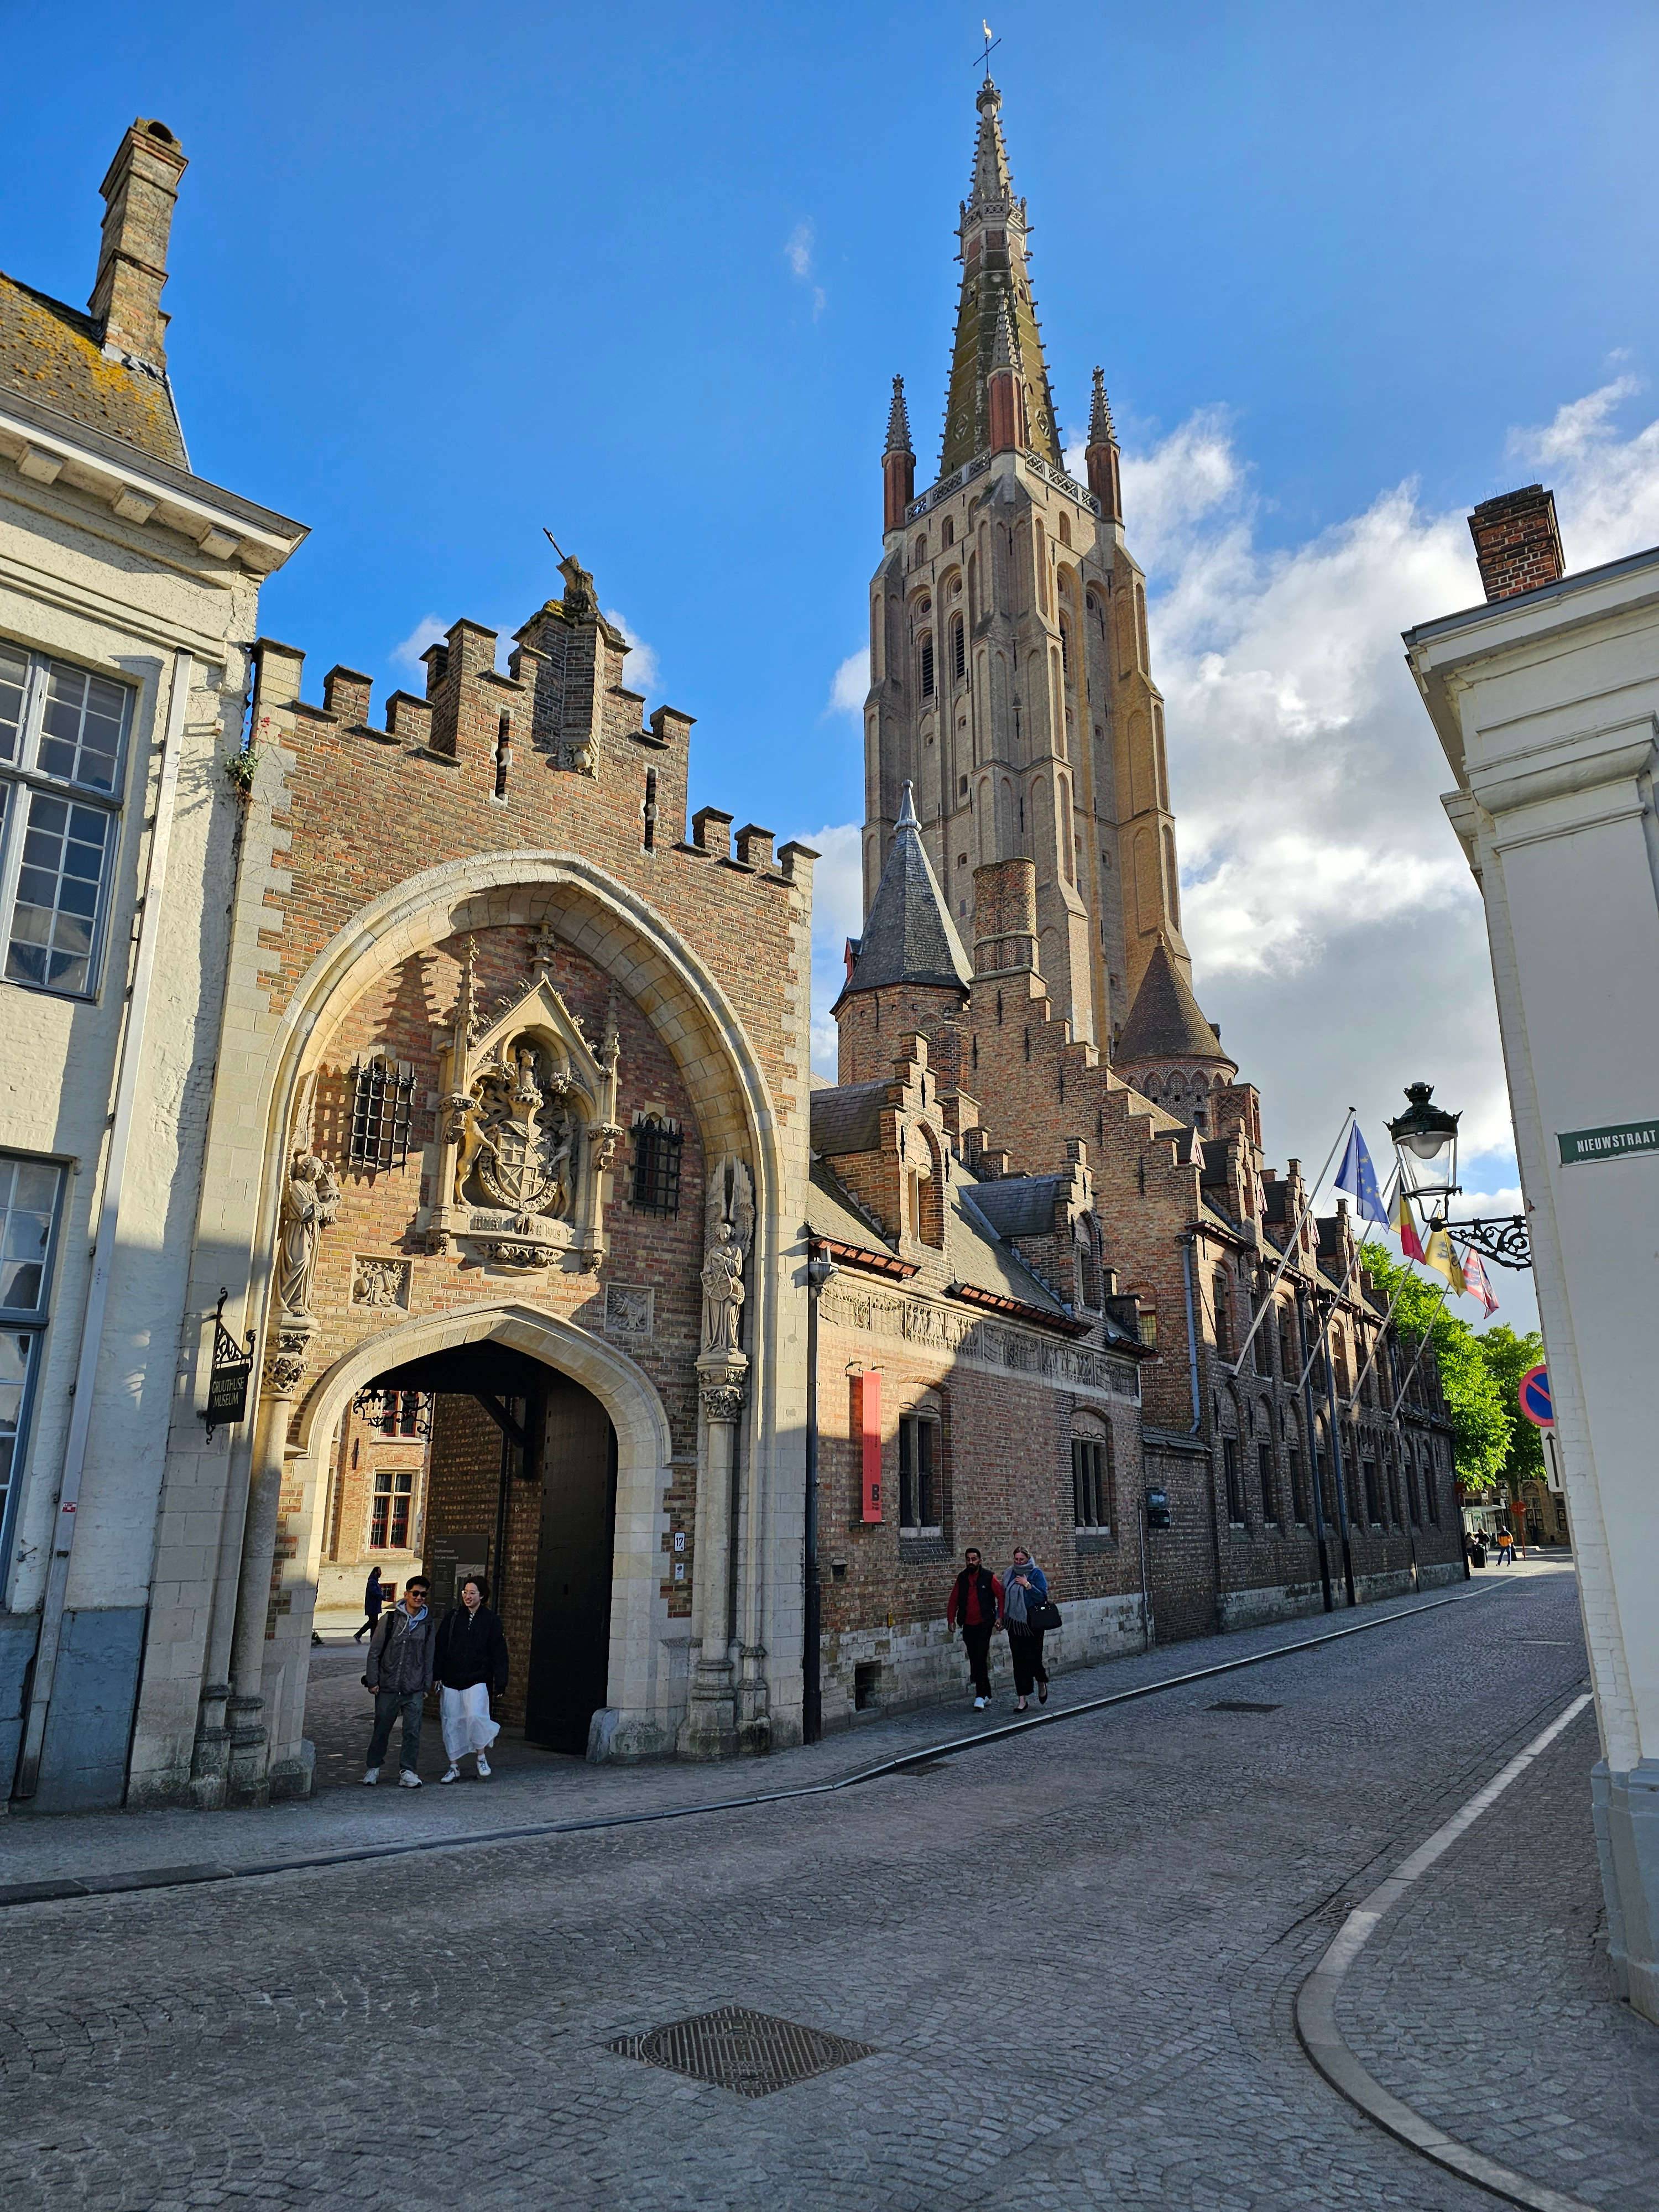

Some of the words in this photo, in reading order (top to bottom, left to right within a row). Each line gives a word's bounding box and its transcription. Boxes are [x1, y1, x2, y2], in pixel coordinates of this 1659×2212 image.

[1577, 1130, 1656, 1152] NIEUWSTRAAT
[212, 1376, 244, 1394] GRUUTHUSE
[212, 1392, 238, 1408] MUSEUM
[872, 1484, 880, 1501] B
[676, 1537, 684, 1547] 17
